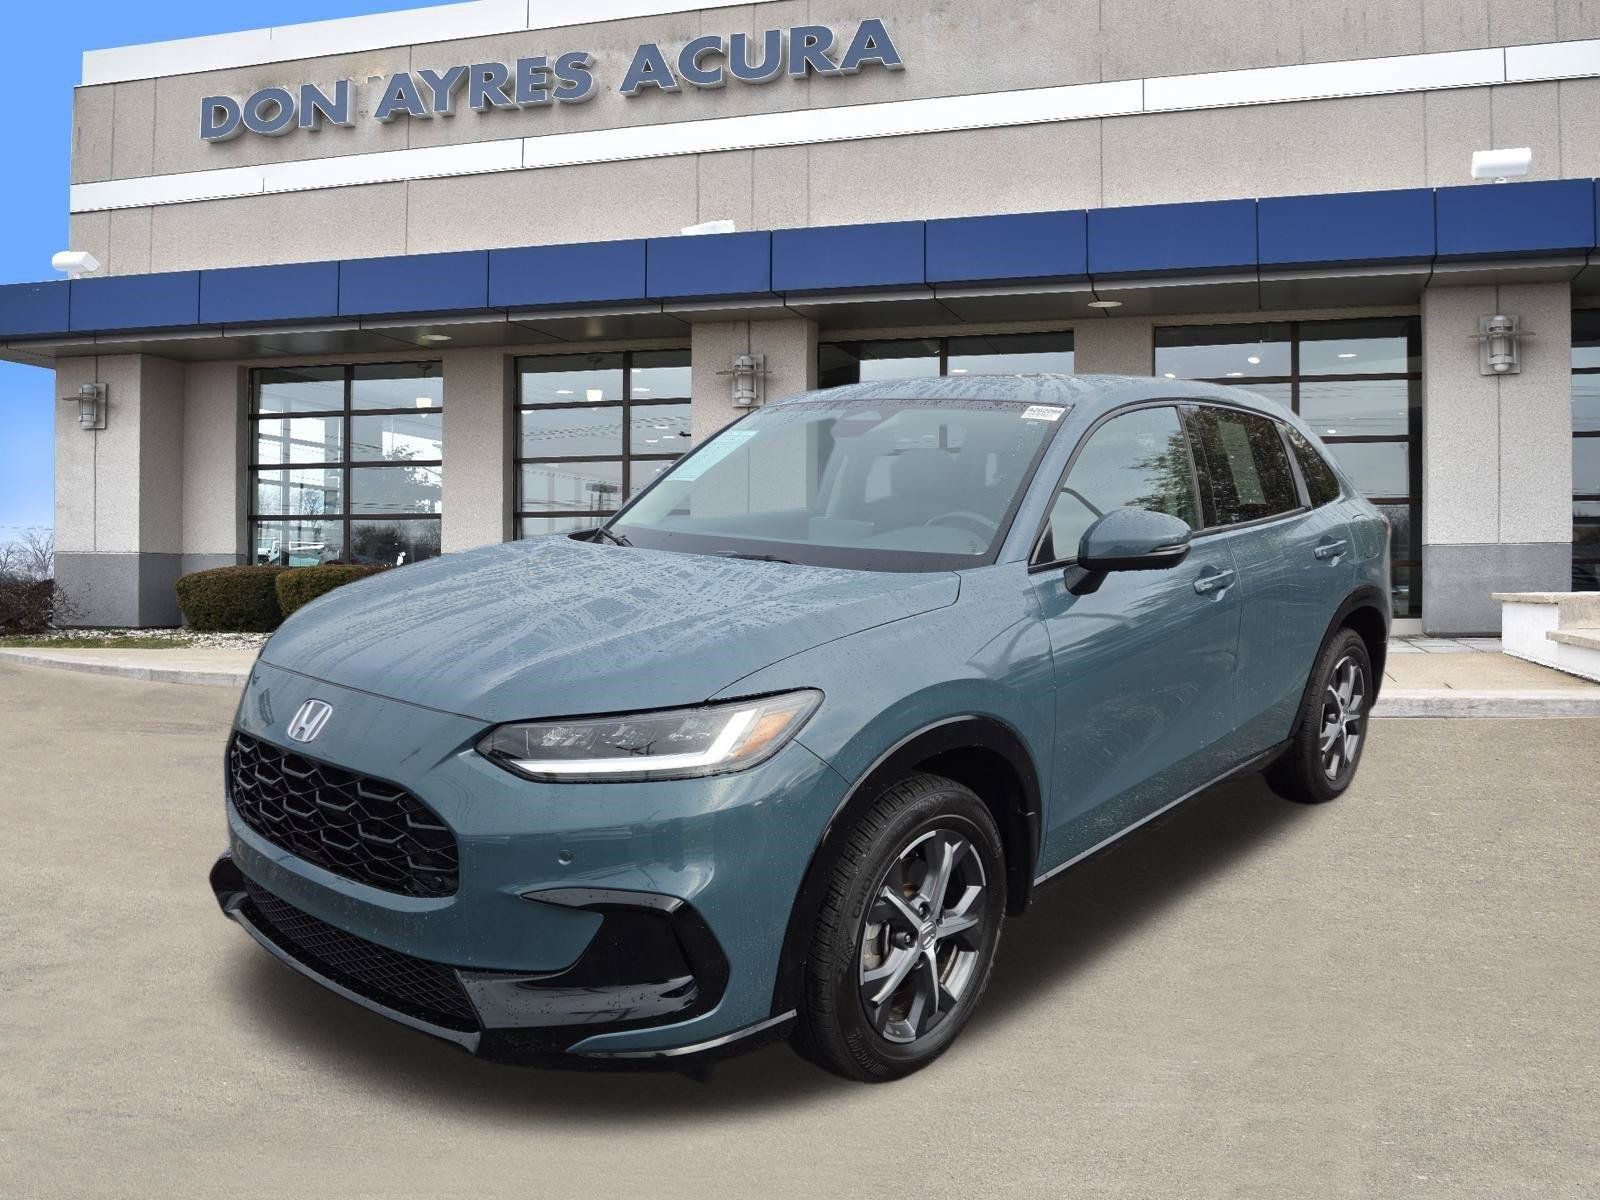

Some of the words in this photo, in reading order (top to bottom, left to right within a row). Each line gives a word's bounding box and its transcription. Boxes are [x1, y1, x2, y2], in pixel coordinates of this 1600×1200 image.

[200, 80, 355, 143] DON
[374, 51, 596, 124] AYRES
[619, 18, 904, 97] ACURA
